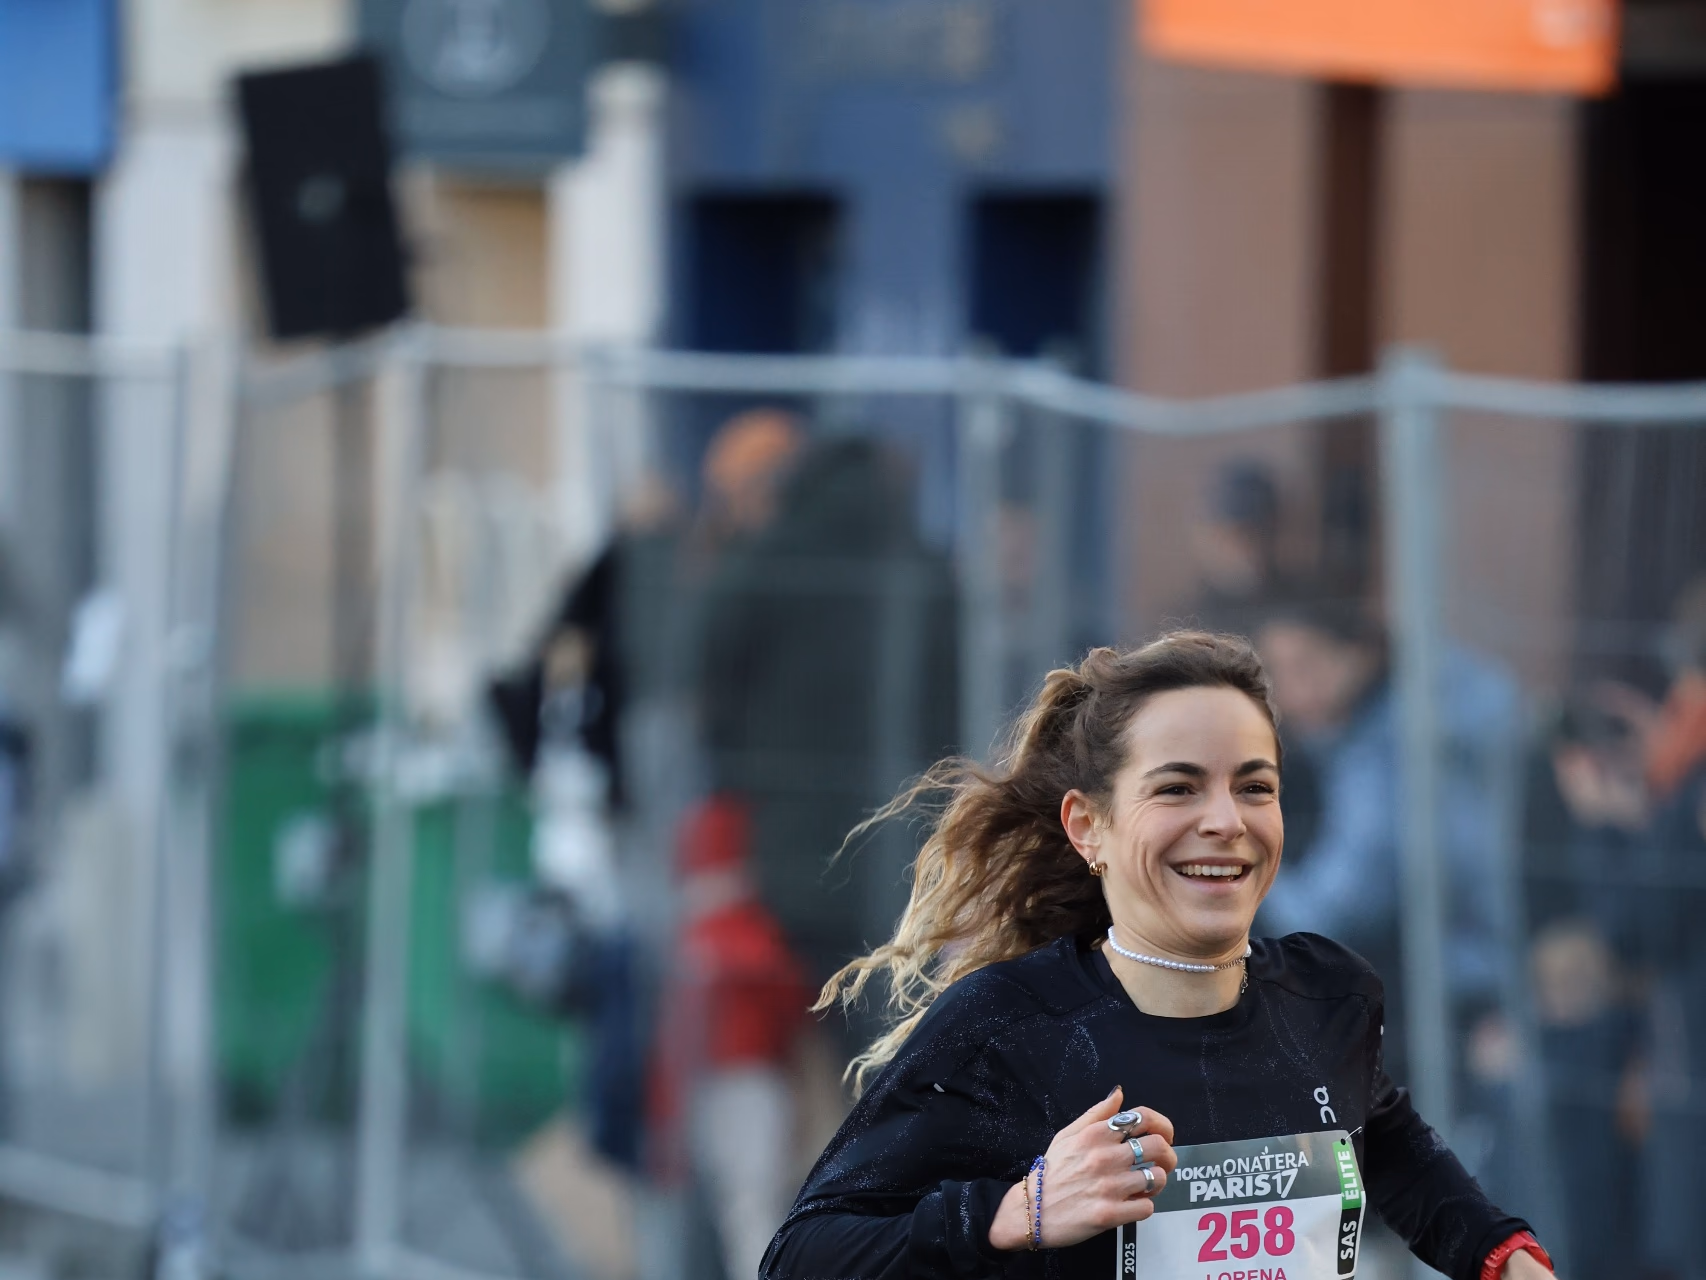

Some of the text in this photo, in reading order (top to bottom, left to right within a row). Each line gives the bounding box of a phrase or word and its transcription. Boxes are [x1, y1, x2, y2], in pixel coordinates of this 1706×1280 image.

[1175, 1146, 1310, 1182] 10KM ONATERA
[1197, 1205, 1296, 1263] 258
[1340, 1220, 1357, 1260] SAS
[1124, 1242, 1136, 1274] 2025
